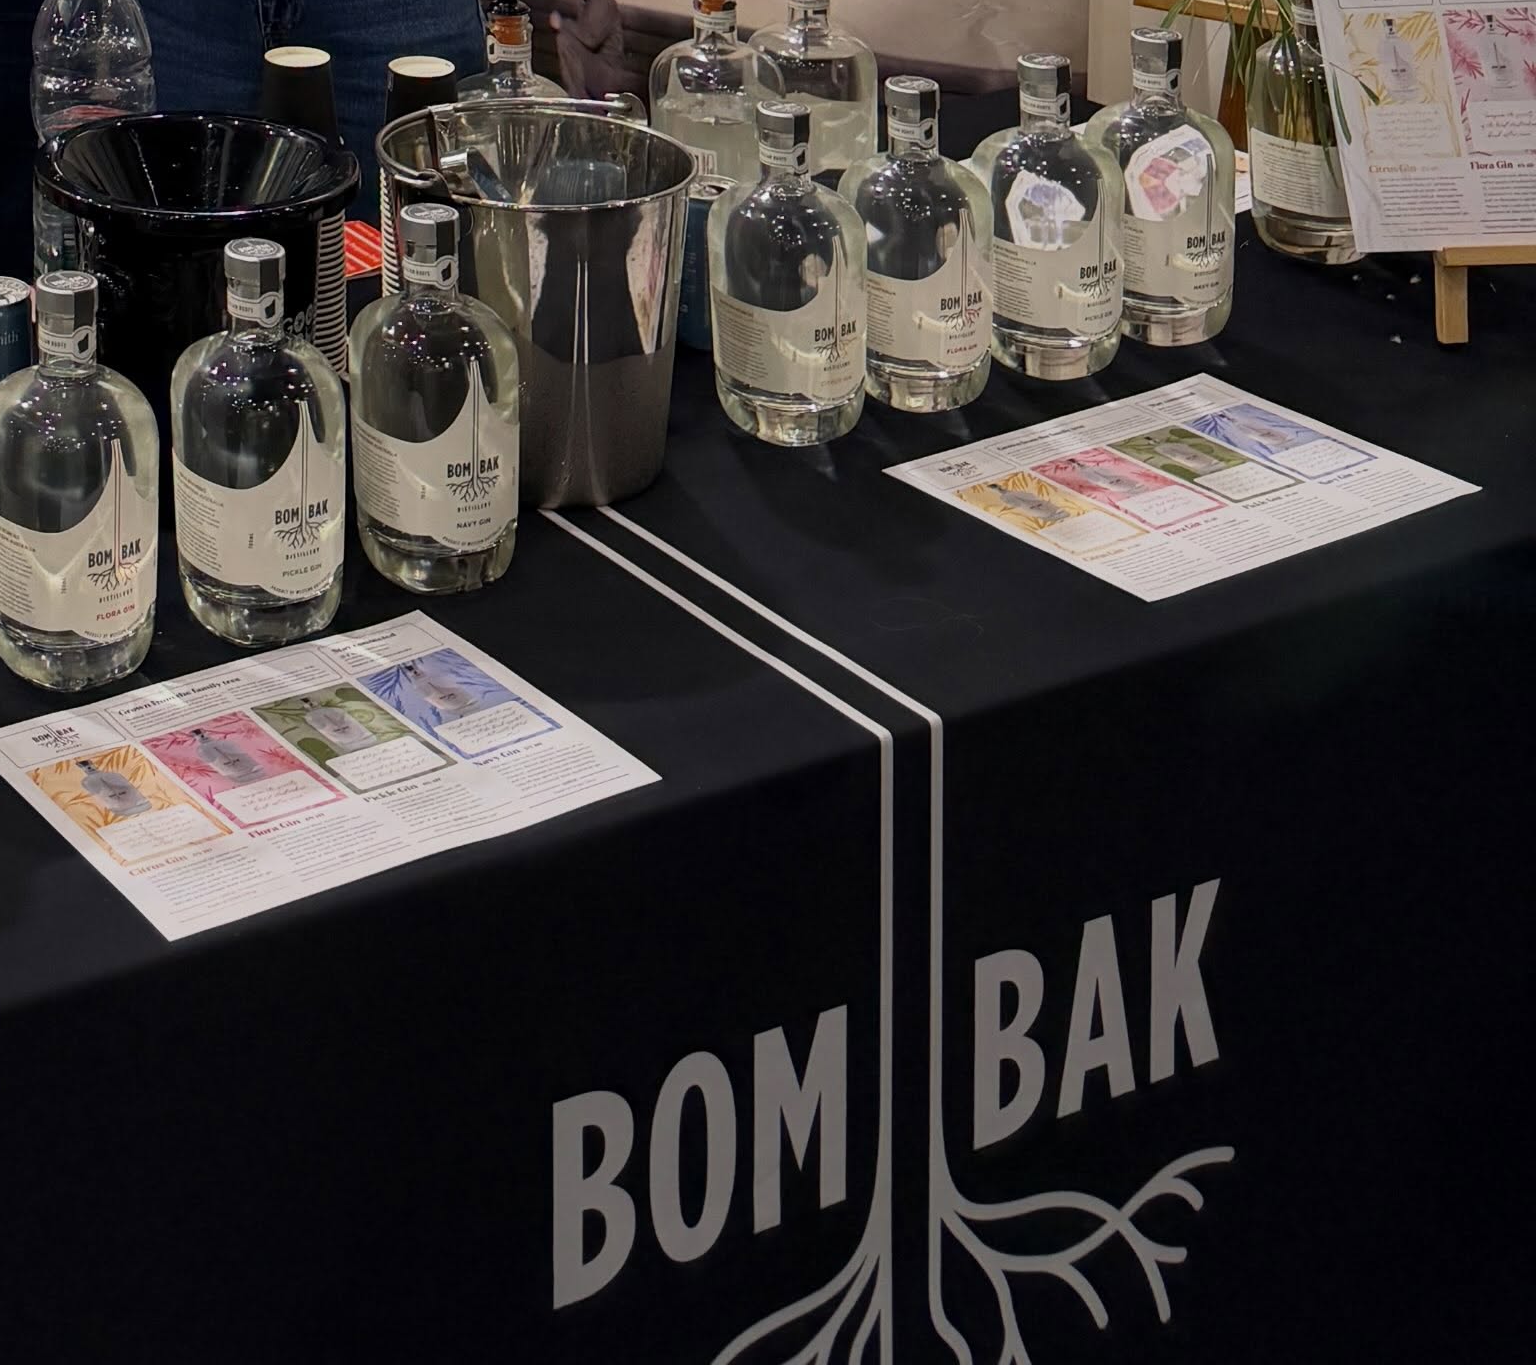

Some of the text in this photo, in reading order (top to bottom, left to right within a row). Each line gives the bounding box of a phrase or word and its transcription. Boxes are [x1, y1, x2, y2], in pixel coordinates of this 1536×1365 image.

[940, 297, 961, 310] BOM
[815, 320, 857, 342] BOM BAK
[447, 455, 500, 479] BOM BAK
[275, 499, 329, 525] BOM BAK
[456, 520, 477, 530] NAVY
[88, 538, 141, 568] BOM BAK
[282, 568, 308, 578] PICKLE
[96, 604, 136, 621] FLORA GIN
[553, 878, 1222, 1311] BOM BAK
